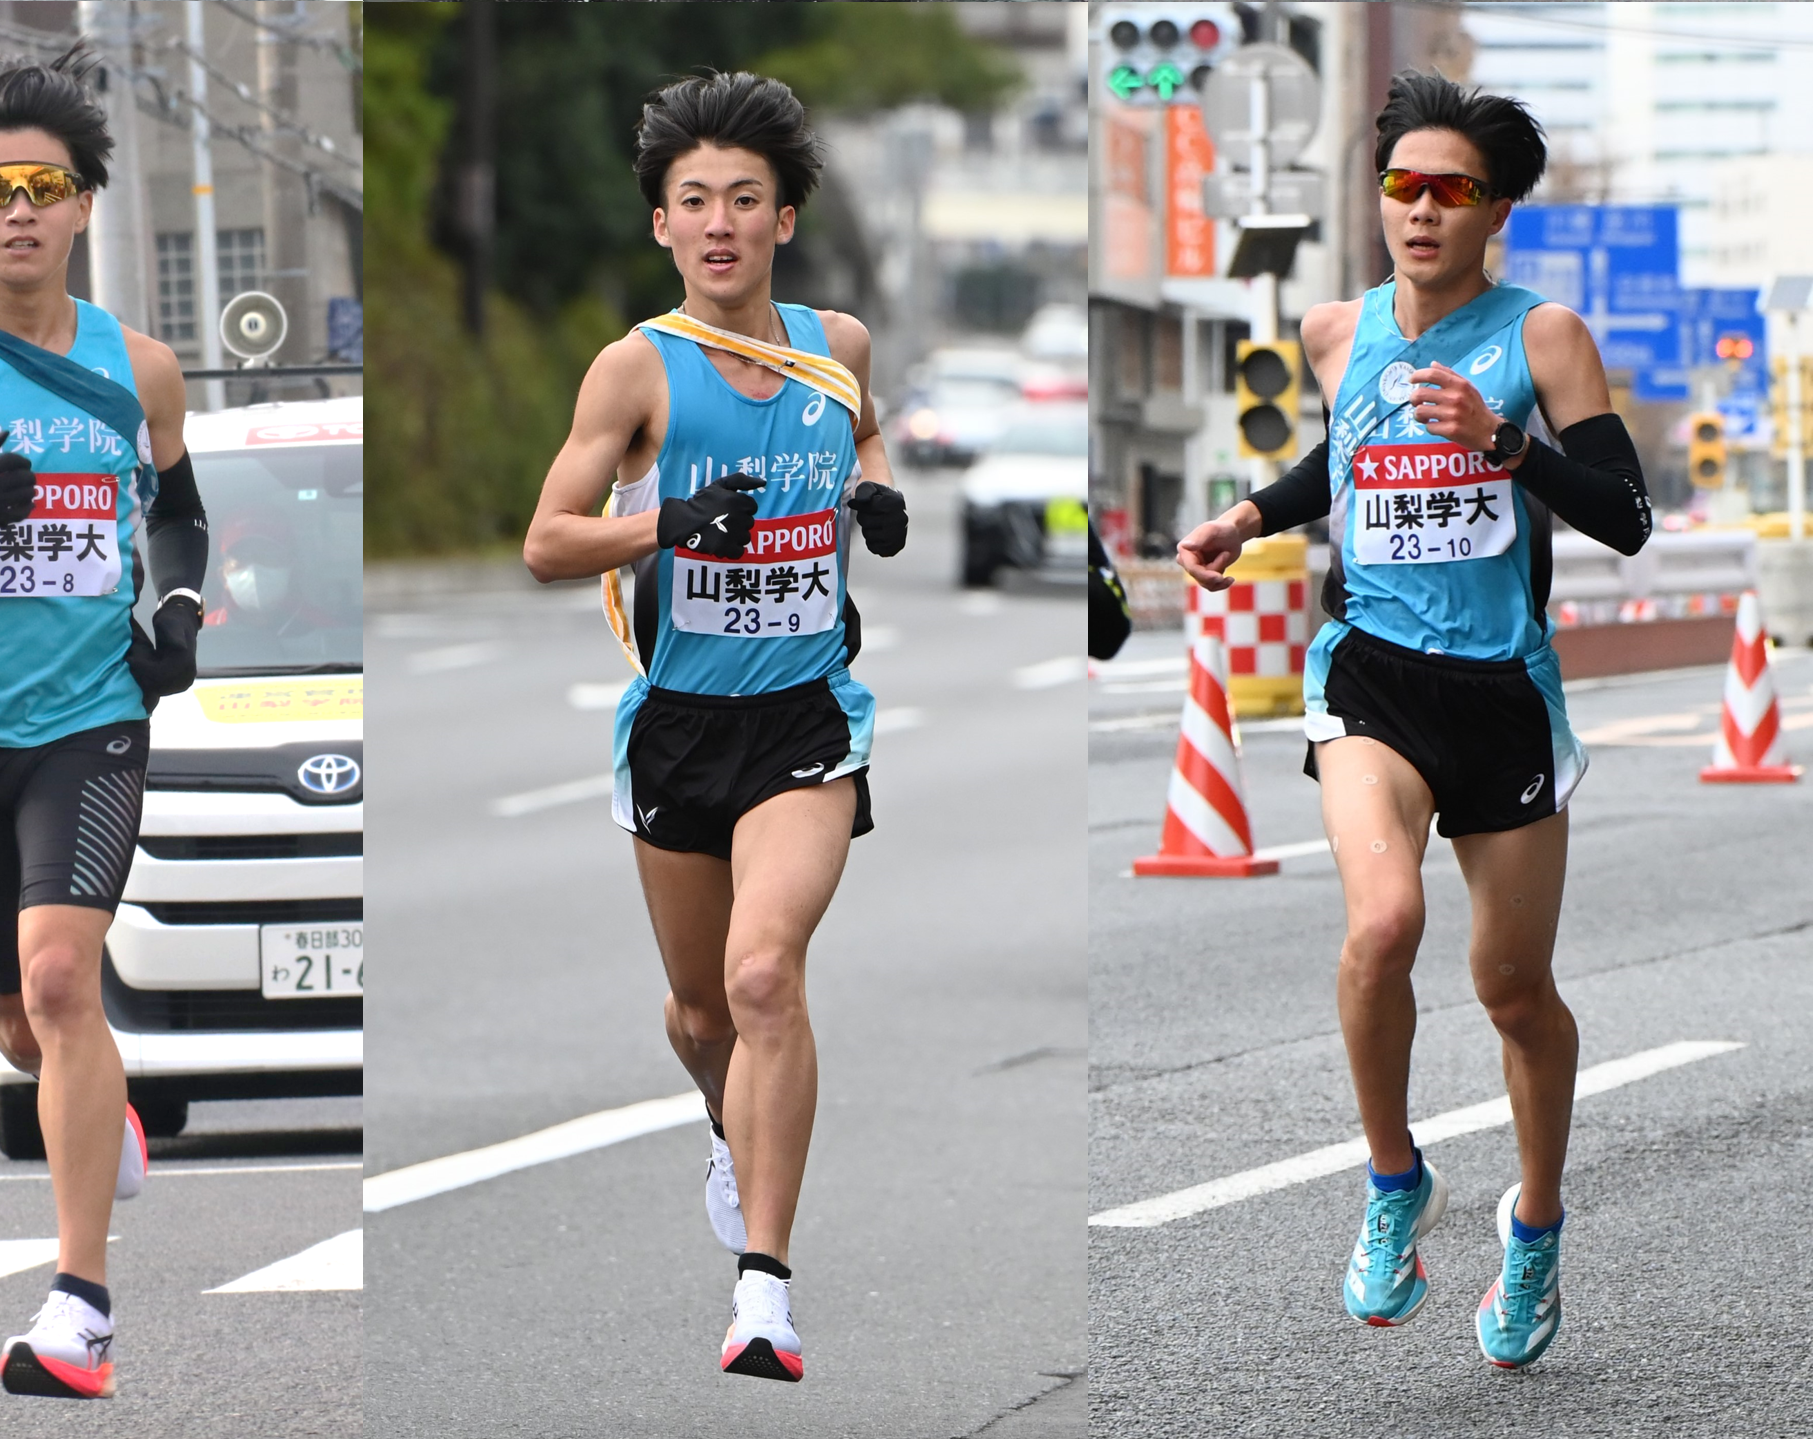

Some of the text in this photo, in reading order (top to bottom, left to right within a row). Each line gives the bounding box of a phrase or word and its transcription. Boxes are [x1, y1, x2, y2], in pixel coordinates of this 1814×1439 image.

[32, 484, 112, 511] PPORO
[1365, 487, 1500, 531] 山梨学大
[743, 521, 833, 555] PPORO
[687, 561, 830, 605] 山梨学大
[272, 965, 290, 981] わ
